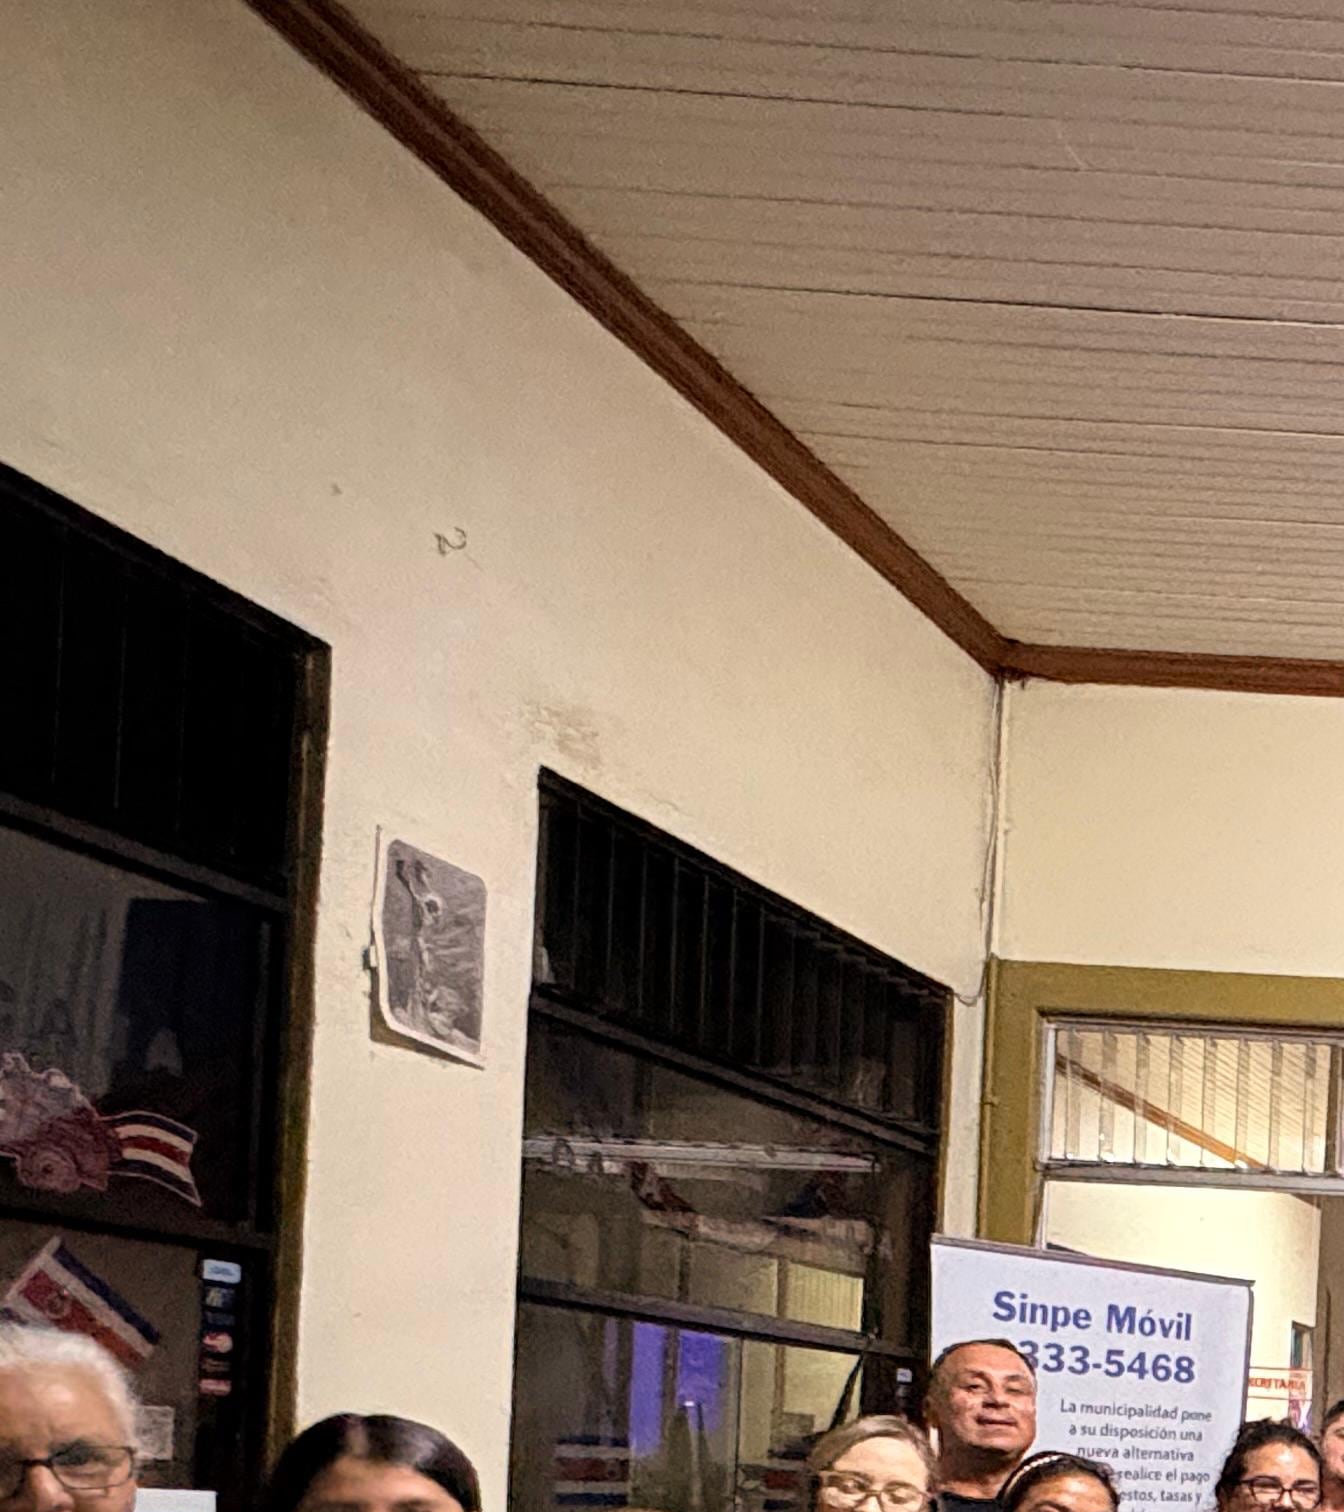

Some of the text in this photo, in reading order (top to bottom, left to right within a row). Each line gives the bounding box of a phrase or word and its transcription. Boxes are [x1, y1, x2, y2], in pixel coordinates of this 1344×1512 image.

[993, 1291, 1193, 1341] Sinpe Móvil
[1017, 1339, 1195, 1384] 333-5468
[1060, 1398, 1212, 1423] La municipalidad pone
[1069, 1423, 1203, 1442] a su disposición una
[1077, 1446, 1194, 1462] nueva alternativa
[1166, 1469, 1177, 1481] el
[1180, 1471, 1211, 1485] pago
[1160, 1489, 1193, 1503] tasas
